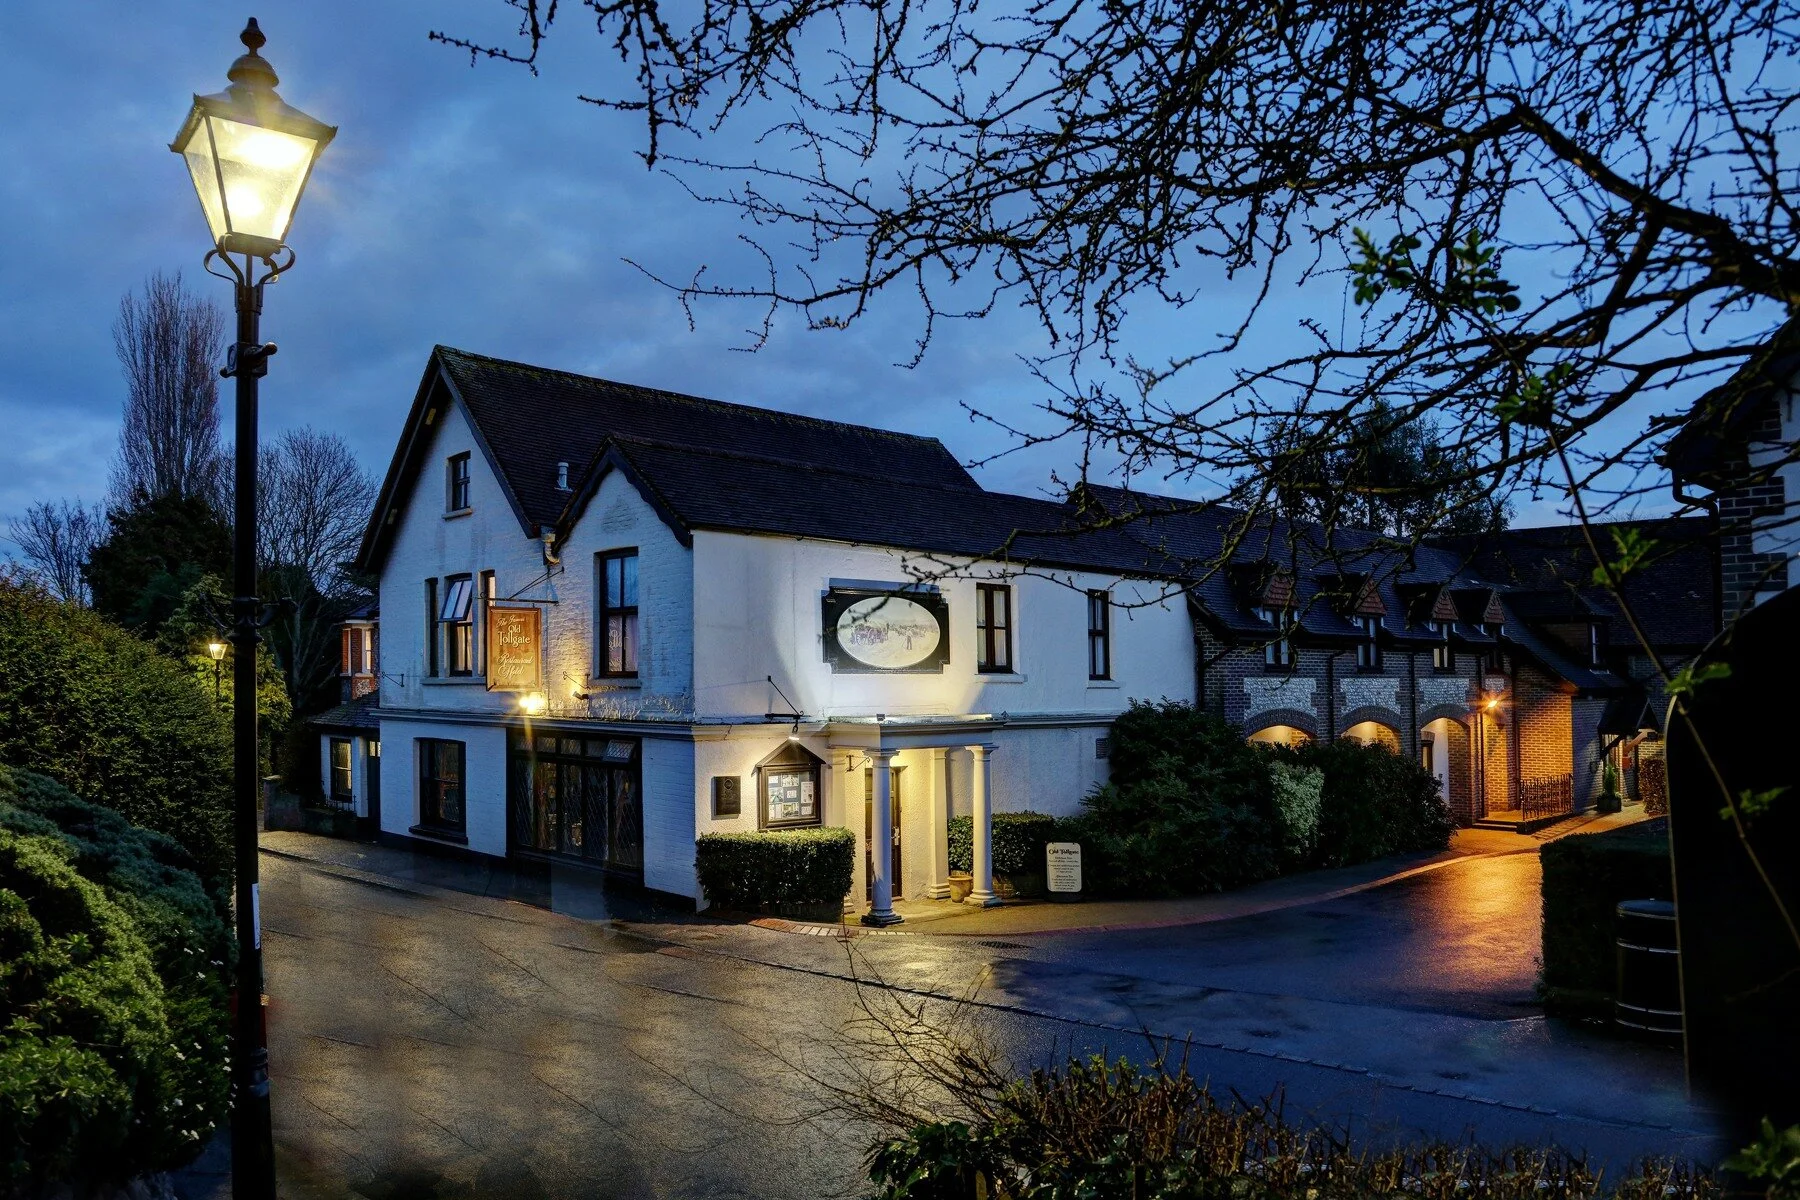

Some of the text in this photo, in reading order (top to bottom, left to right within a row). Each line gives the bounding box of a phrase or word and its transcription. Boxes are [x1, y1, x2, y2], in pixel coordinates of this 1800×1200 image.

[508, 624, 520, 632] Old
[498, 630, 531, 647] Tollgate
[497, 653, 533, 665] Restaurant
